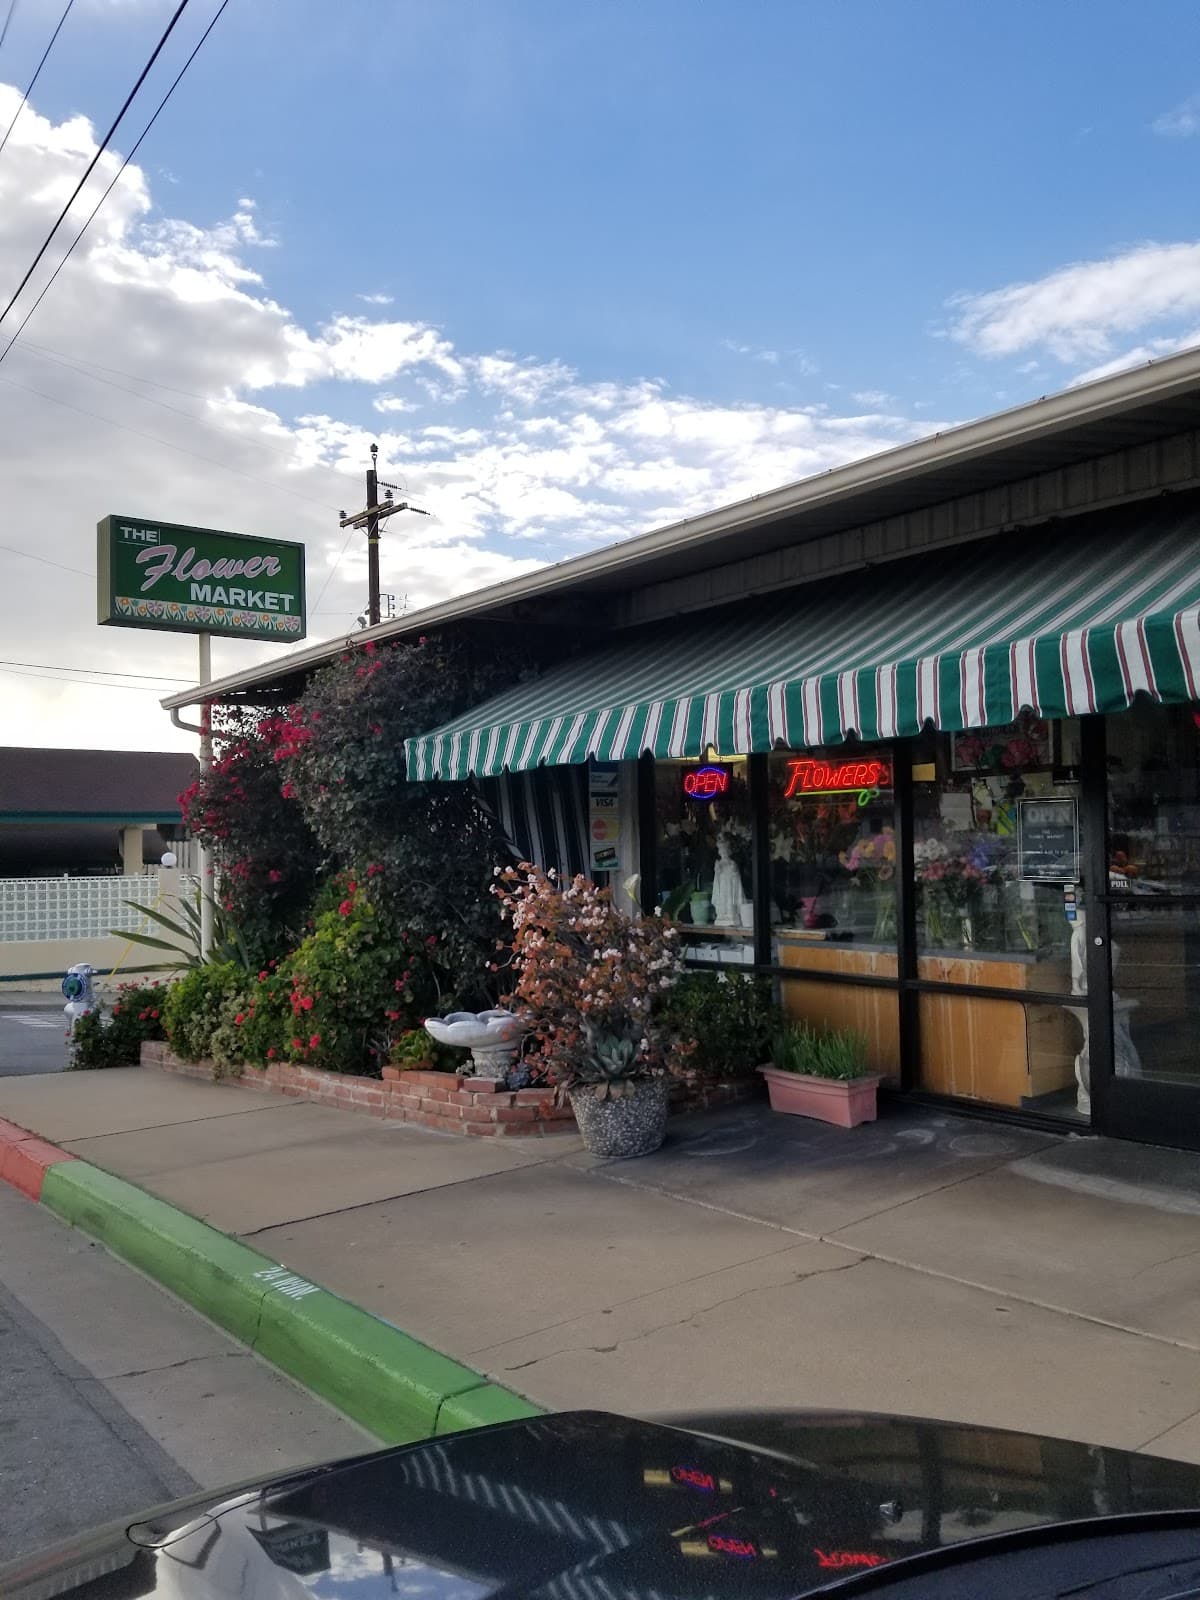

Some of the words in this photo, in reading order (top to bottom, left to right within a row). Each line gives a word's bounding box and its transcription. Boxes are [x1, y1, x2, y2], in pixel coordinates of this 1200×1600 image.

[119, 526, 159, 543] THE
[135, 545, 282, 592] Flower
[190, 583, 295, 612] MARKET
[684, 772, 728, 794] OPEN
[784, 759, 882, 799] FLOWERS
[595, 798, 614, 807] VISA
